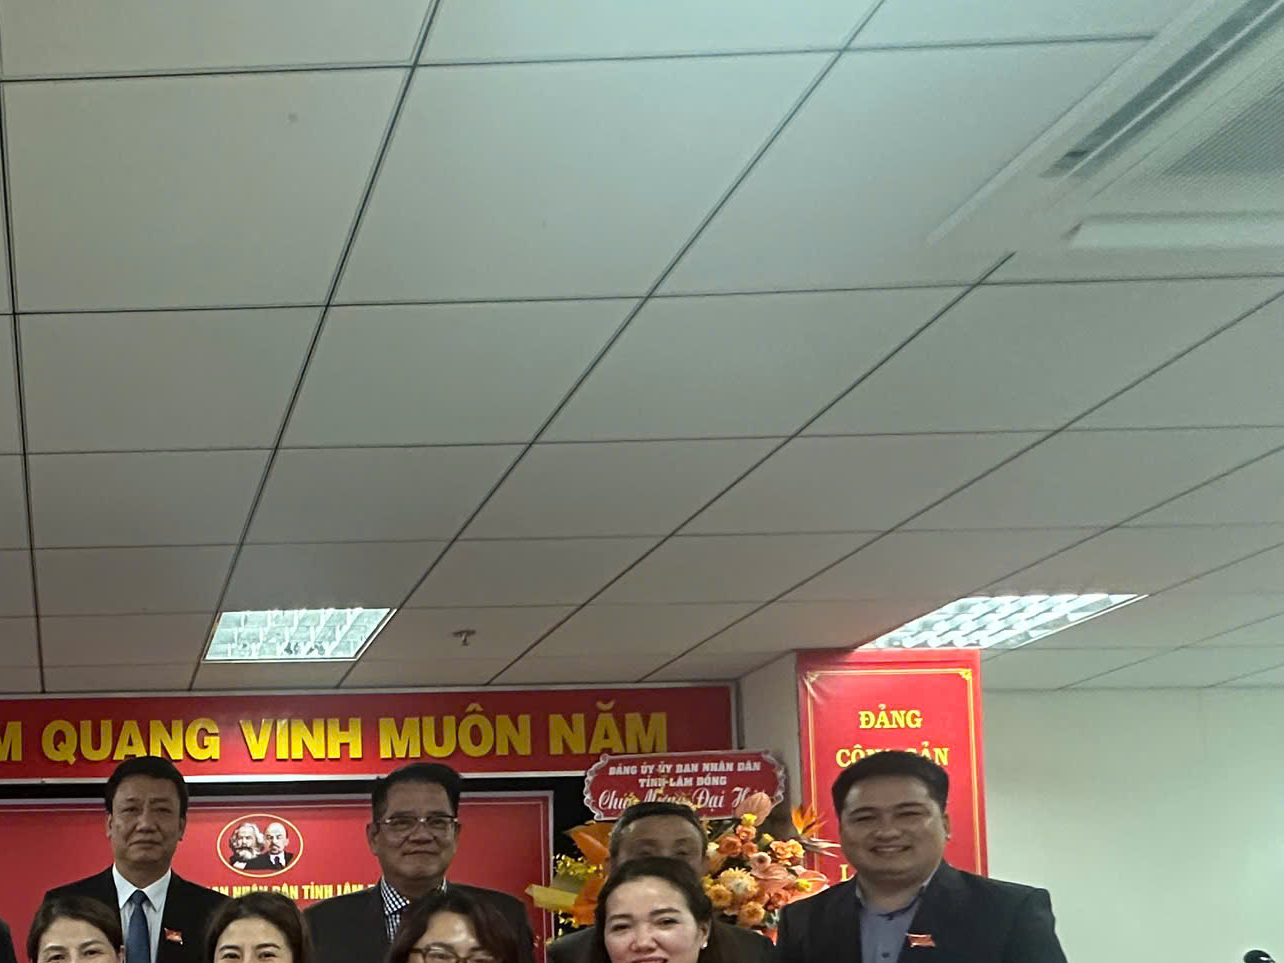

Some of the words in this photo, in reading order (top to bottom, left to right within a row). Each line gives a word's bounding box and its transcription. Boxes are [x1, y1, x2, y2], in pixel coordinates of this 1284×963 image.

[859, 704, 923, 729] ĐẢNG
[41, 717, 221, 765] QUANG
[239, 716, 362, 760] VINH
[379, 703, 532, 758] MUÔN
[549, 700, 668, 755] NĂM
[676, 762, 699, 774] BAN
